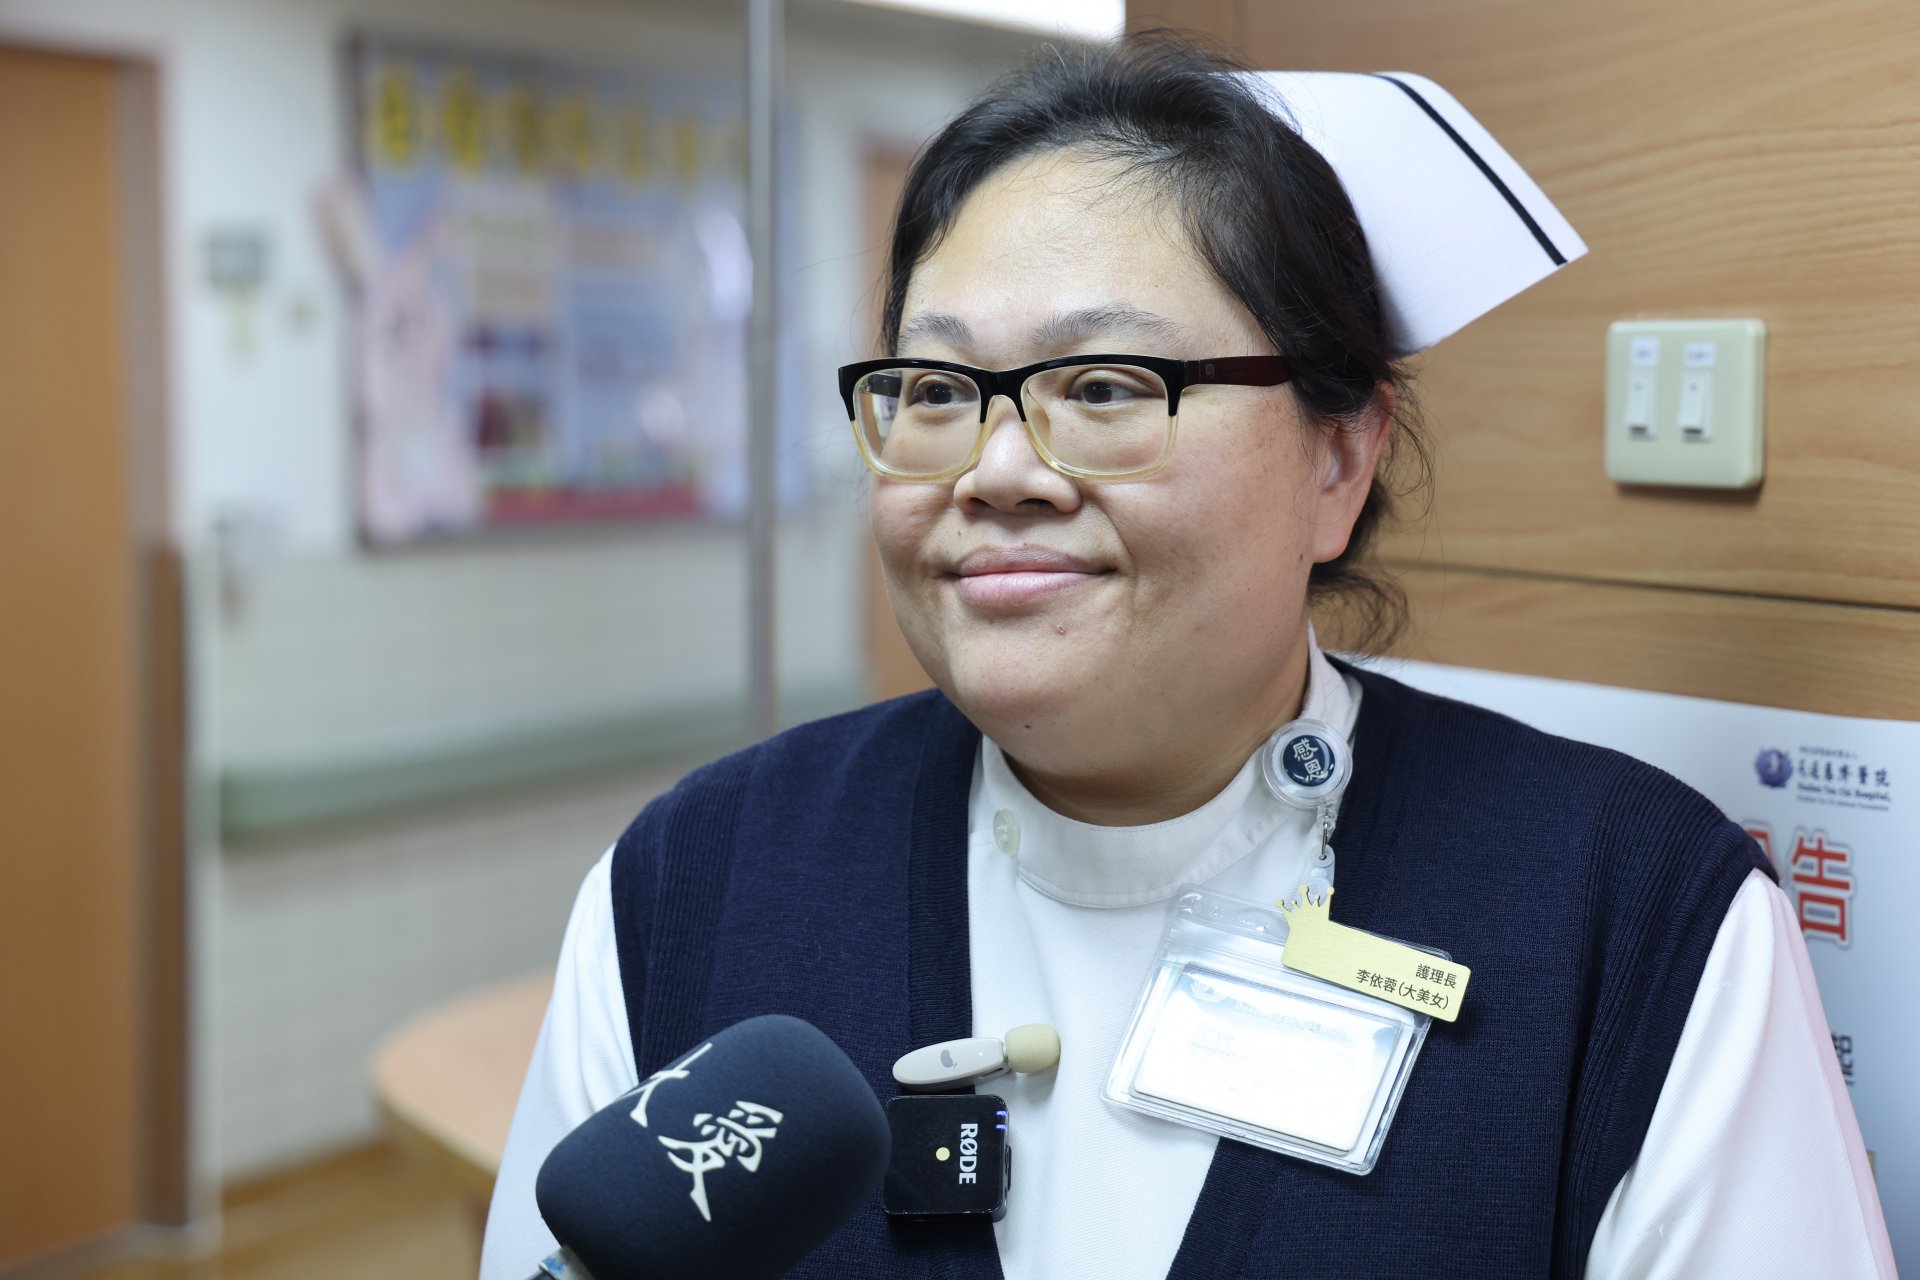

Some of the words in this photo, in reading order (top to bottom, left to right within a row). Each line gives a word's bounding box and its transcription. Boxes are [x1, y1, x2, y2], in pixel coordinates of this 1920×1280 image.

[1292, 737, 1329, 783] 感恩
[1415, 963, 1457, 989] 護理長
